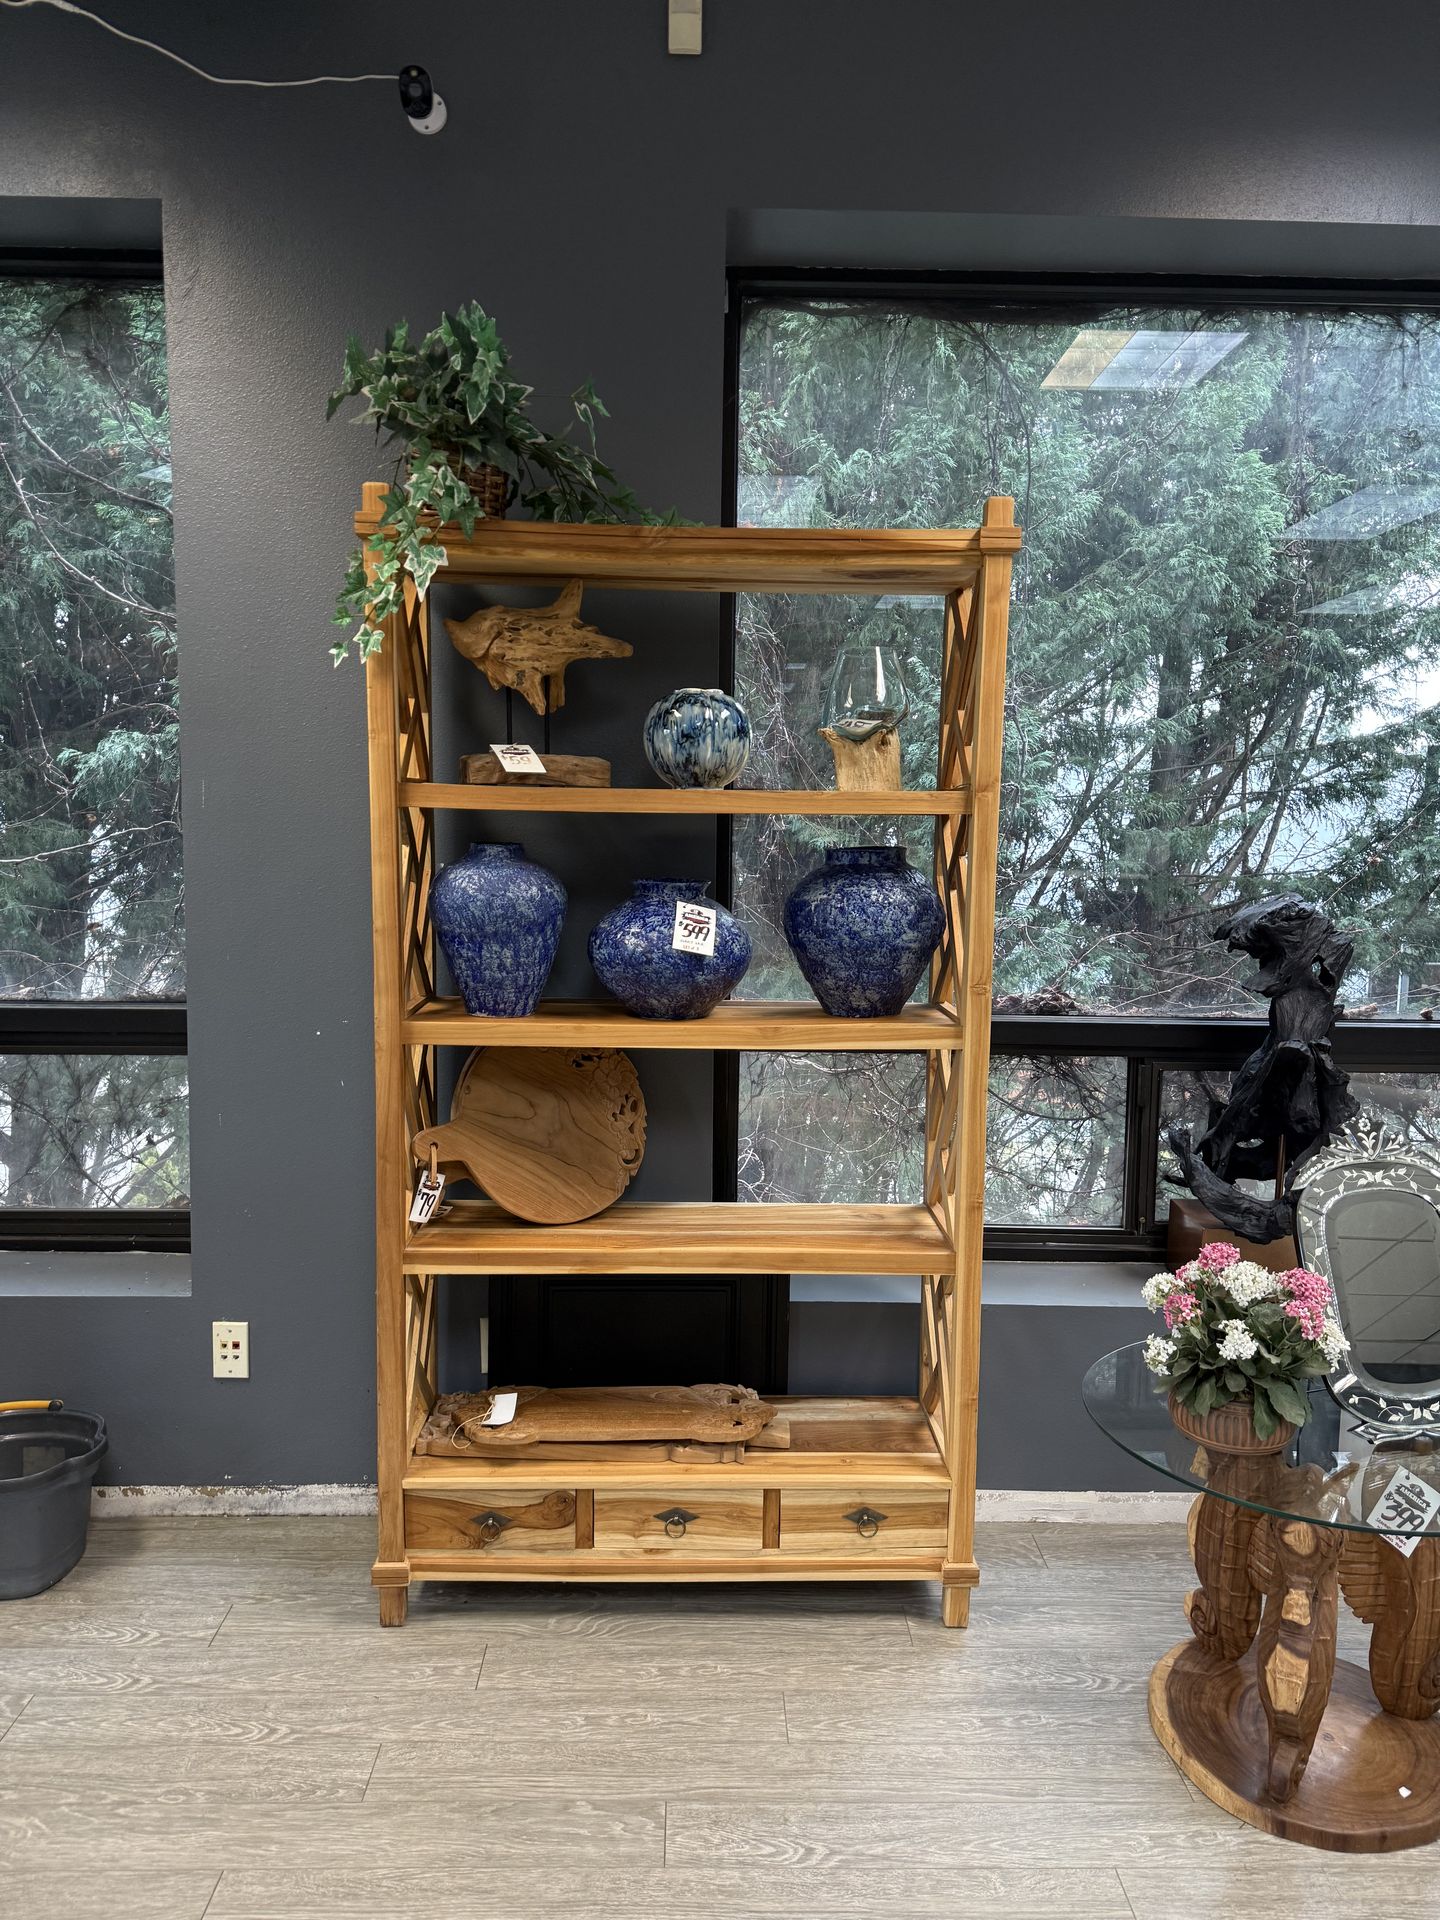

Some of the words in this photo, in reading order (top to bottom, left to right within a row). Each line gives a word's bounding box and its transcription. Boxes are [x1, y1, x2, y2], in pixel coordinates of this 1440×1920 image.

[678, 920, 711, 942] $599
[416, 1188, 437, 1218] $79
[1399, 1485, 1428, 1510] AMERICA
[1380, 1490, 1426, 1541] $399
